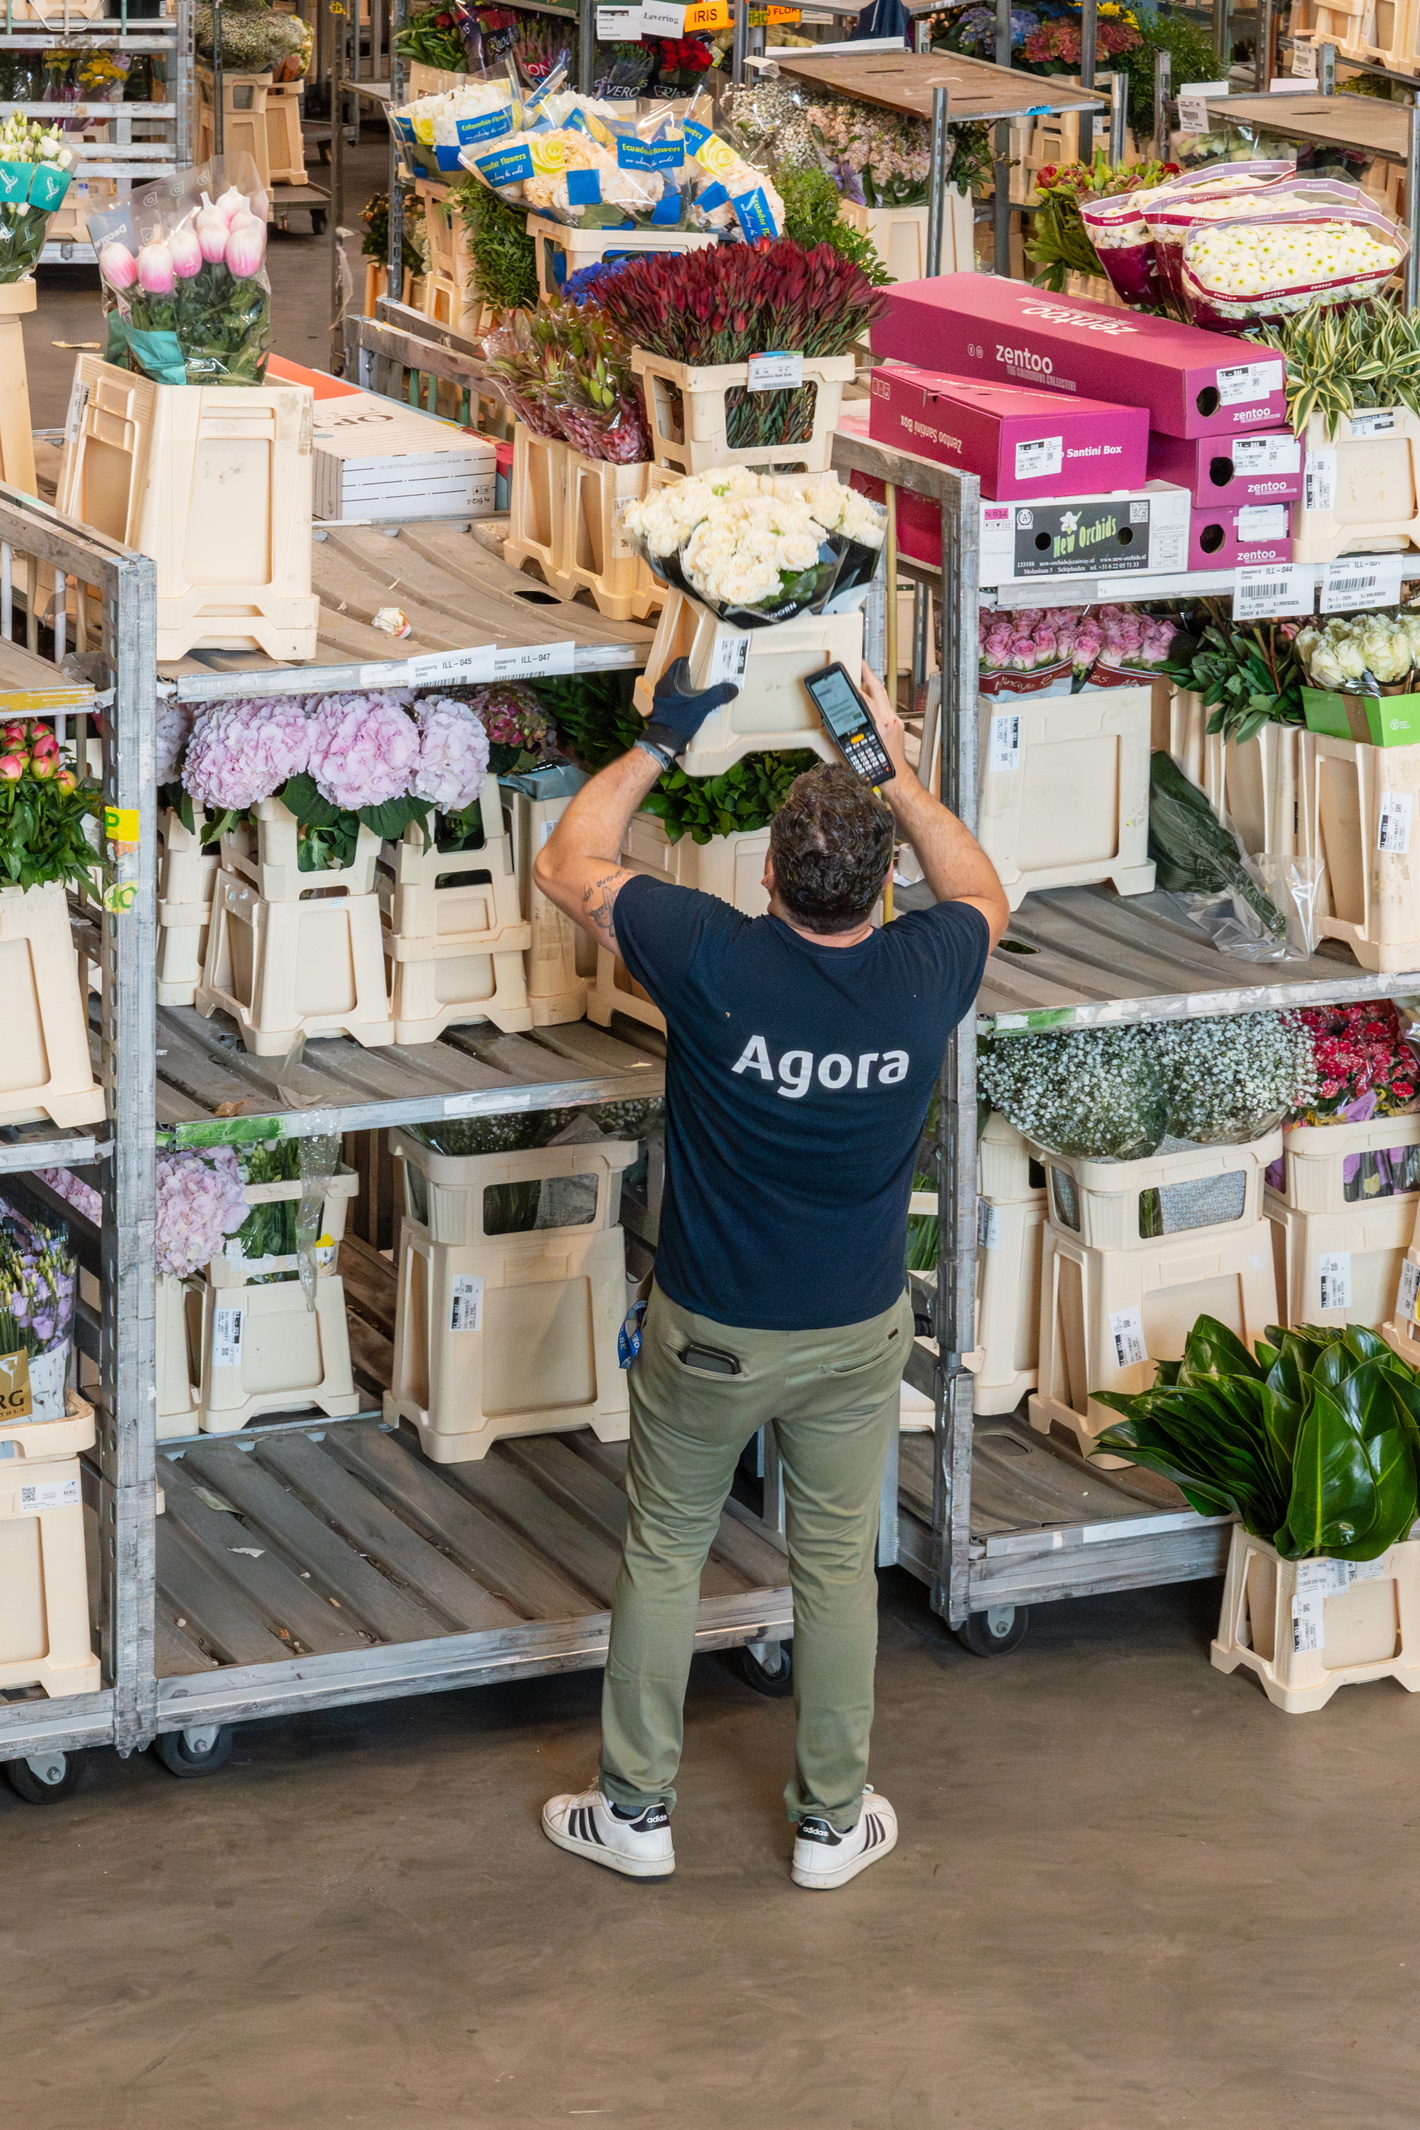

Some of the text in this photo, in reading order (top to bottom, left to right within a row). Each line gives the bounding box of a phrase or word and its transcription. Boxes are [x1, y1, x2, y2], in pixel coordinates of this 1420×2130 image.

[643, 12, 680, 25] Levering
[693, 8, 718, 24] IRIS
[500, 152, 527, 166] Flowers
[1102, 217, 1124, 225] zentoo
[1213, 272, 1376, 301] zentoo zentoo zentoo zentoo
[1021, 306, 1140, 336] zentoo
[995, 344, 1053, 375] zentoo
[1233, 407, 1271, 422] zentoo
[900, 414, 963, 454] Zentoo Santini Box
[1066, 444, 1101, 458] Santini
[1103, 444, 1123, 455] Box
[1247, 481, 1287, 493] zentoo
[1053, 515, 1117, 559] New Orchids
[1236, 549, 1277, 561] zentoo
[731, 1034, 910, 1099] Agora
[802, 1825, 830, 1838] adidas
